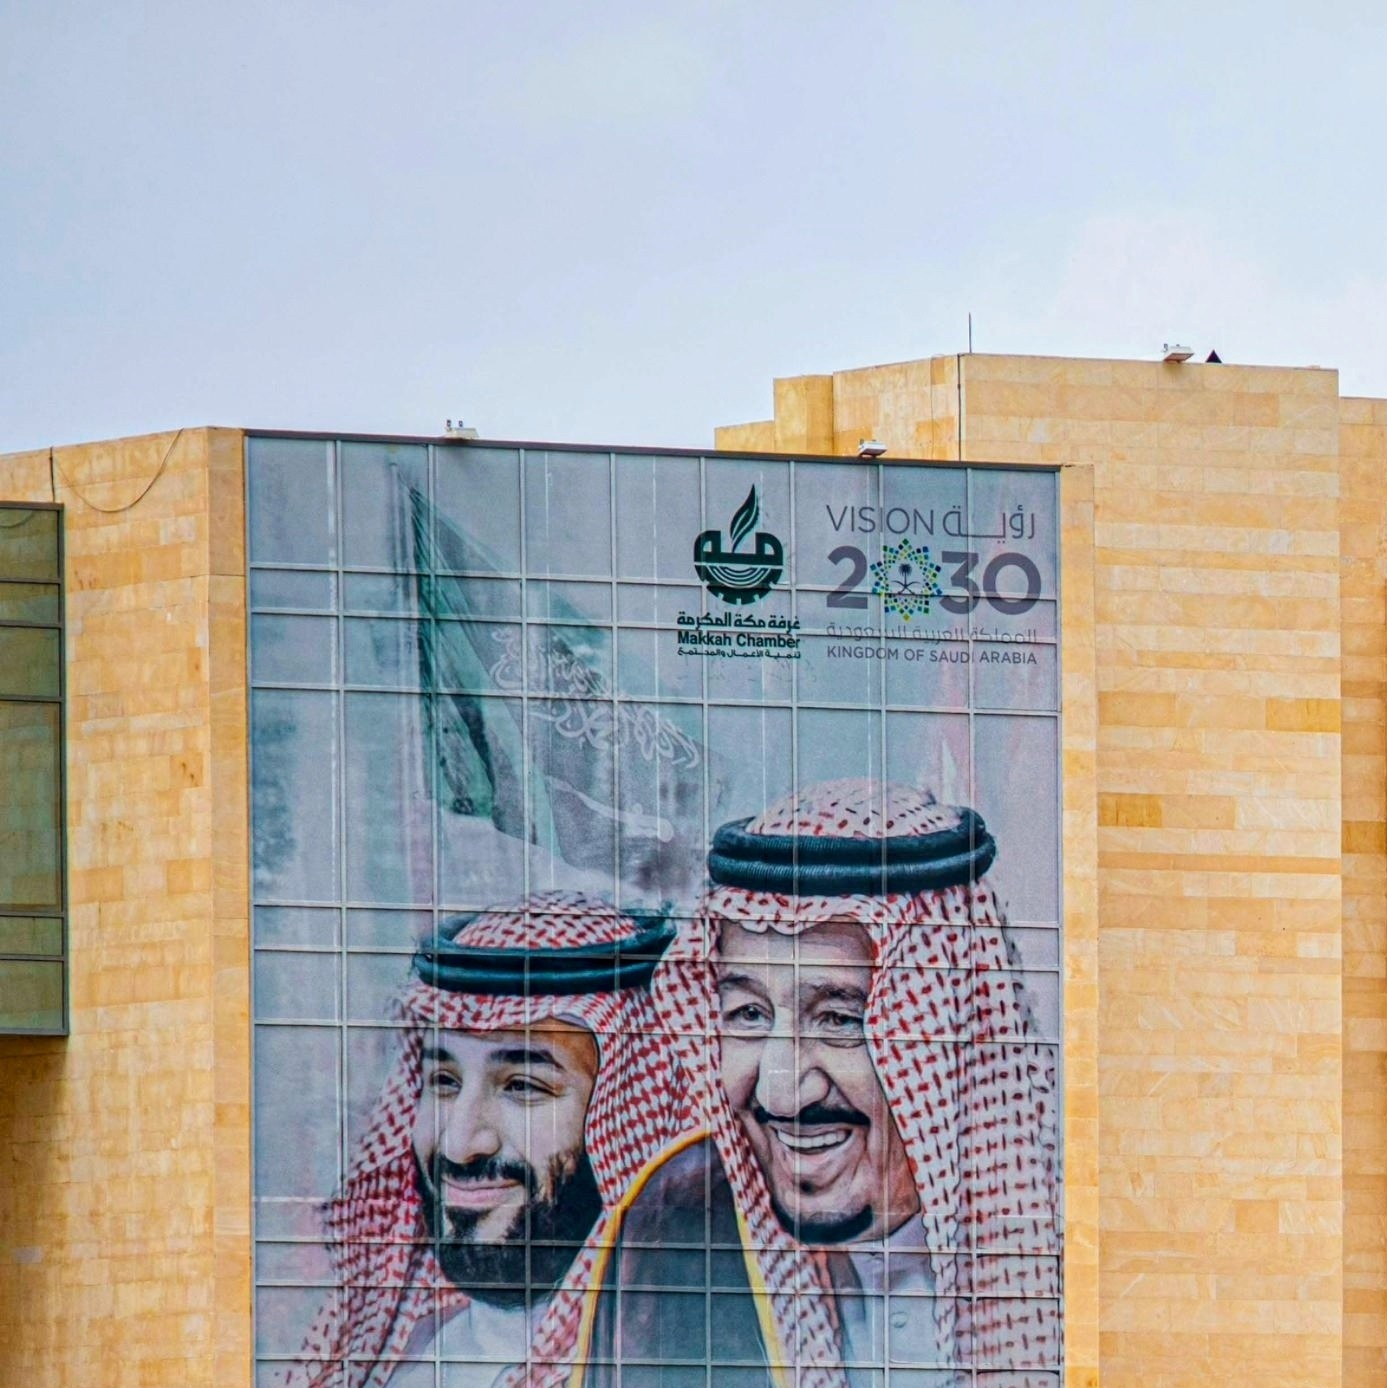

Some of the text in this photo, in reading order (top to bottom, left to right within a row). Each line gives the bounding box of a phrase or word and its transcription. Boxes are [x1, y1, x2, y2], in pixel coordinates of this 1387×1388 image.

[826, 504, 934, 535] VISION
[942, 504, 1036, 545] رؤية
[677, 611, 800, 633] غرفة مكة المكرمة
[677, 631, 801, 649] Makkah Chamber
[826, 645, 1038, 666] KINGDOM OF SAUDI ARABIA
